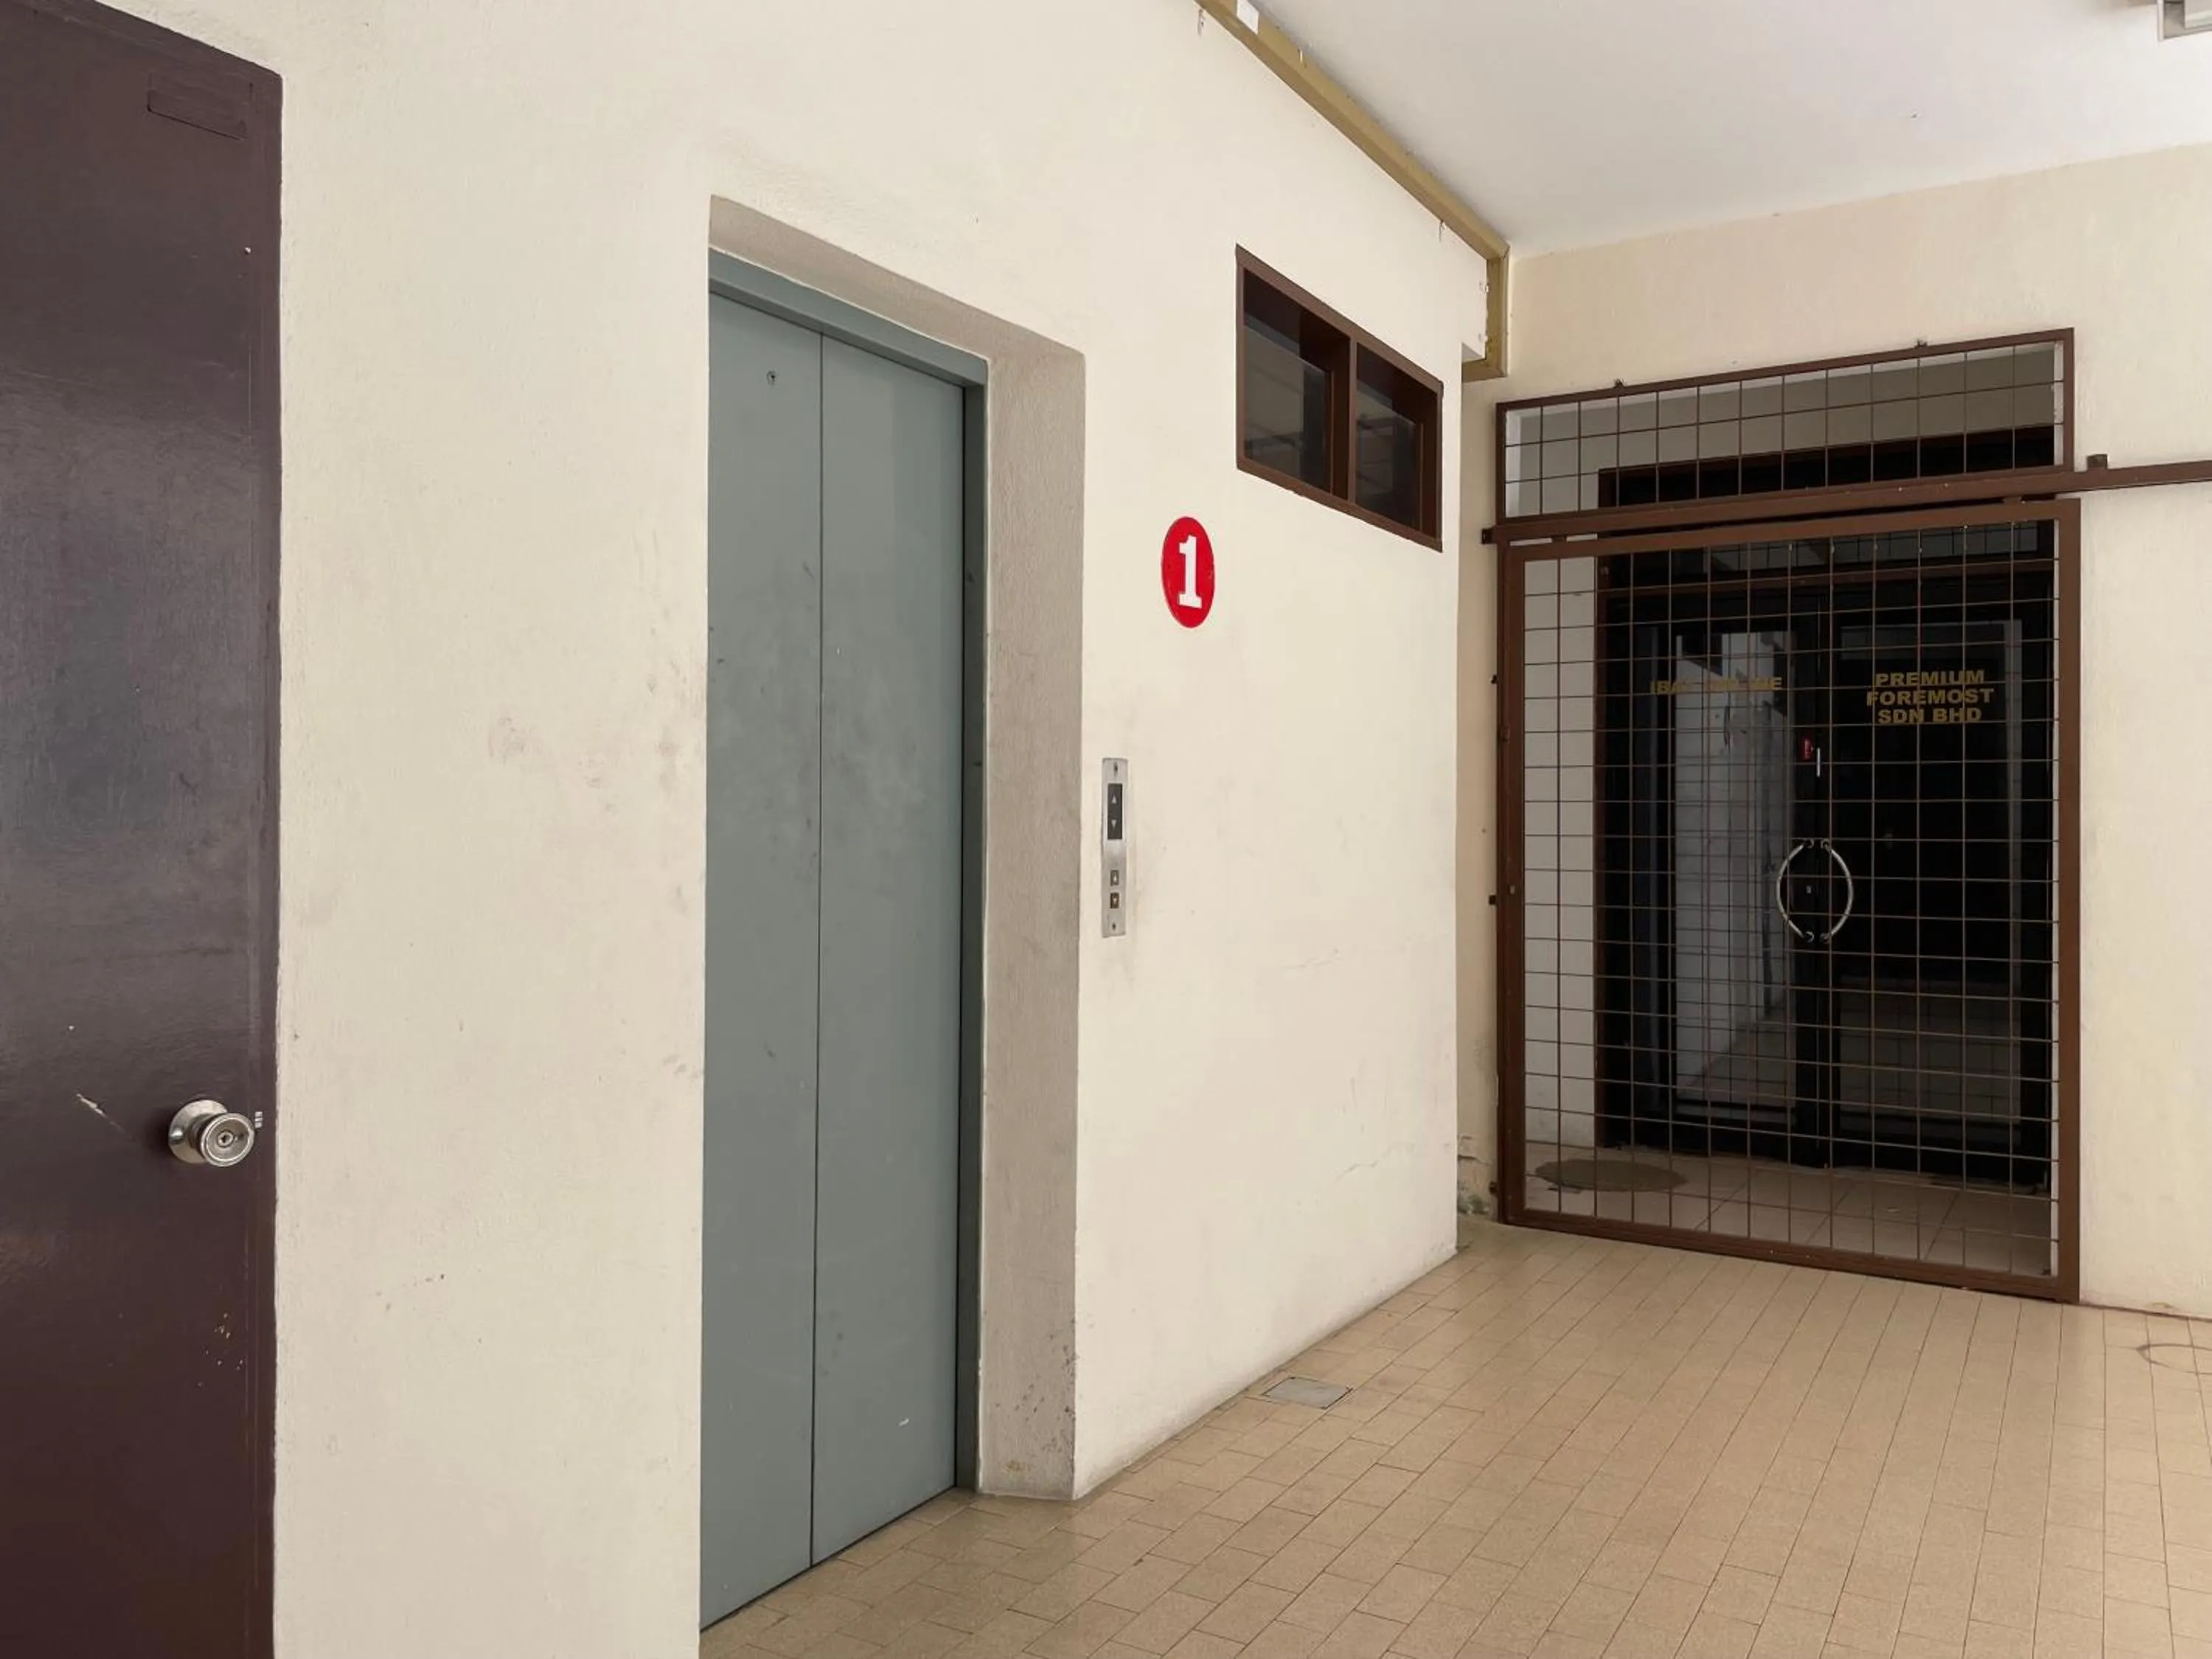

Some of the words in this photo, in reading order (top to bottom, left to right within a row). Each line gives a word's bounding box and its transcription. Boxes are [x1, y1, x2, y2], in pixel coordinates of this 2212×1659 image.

[1178, 534, 1203, 608] 1
[1875, 669, 1985, 687] PREMIUM
[1866, 688, 1994, 706] FOREMOST
[1878, 709, 1925, 724] SDN
[1932, 707, 1982, 723] BHD
